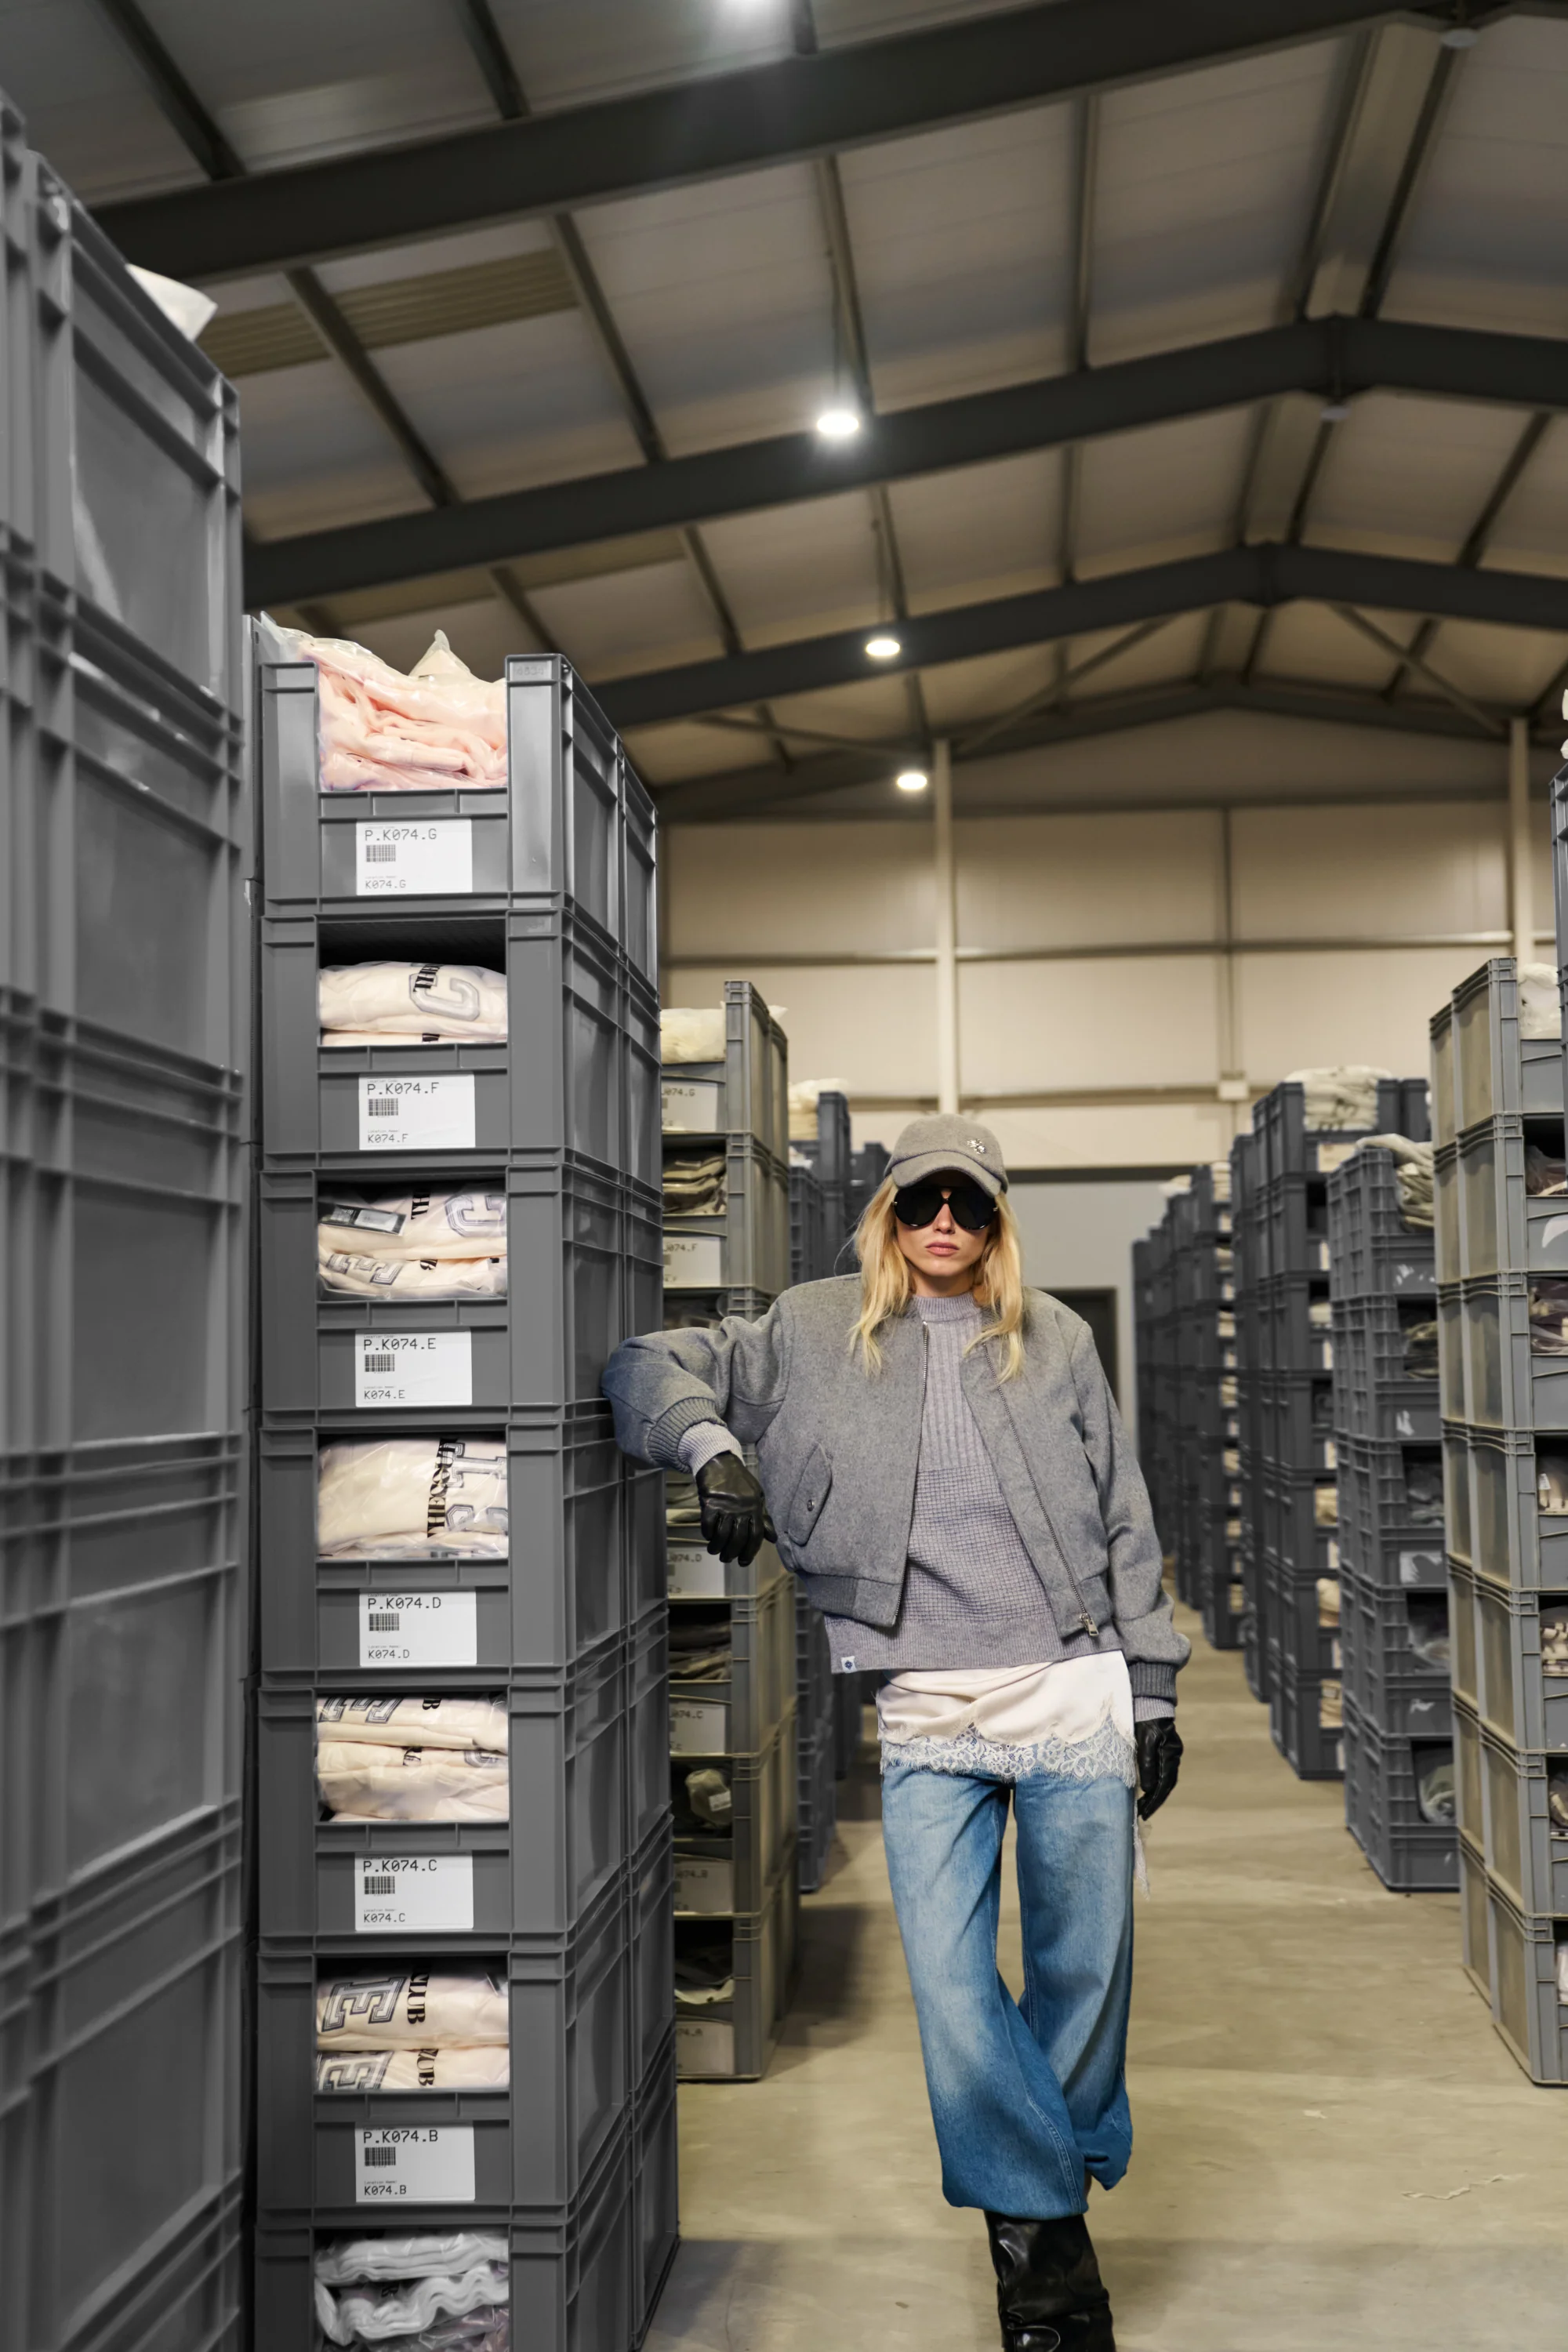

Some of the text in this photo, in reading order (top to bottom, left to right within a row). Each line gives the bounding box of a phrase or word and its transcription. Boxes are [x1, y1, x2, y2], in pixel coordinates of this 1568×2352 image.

[365, 828, 437, 841] P.K074.G
[365, 879, 406, 889] K074.G
[367, 1082, 439, 1095] P.K074.F
[367, 1134, 408, 1143] K074.F
[364, 1338, 437, 1351] P.K074.E
[364, 1389, 405, 1399] K074.E
[368, 1597, 441, 1610] P.K074.D
[368, 1649, 410, 1659] K074.D
[363, 1859, 437, 1872] P.K074.C
[364, 1913, 405, 1923] K074.C
[363, 2129, 438, 2143] P.K074.B
[364, 2185, 407, 2196] K074.B
